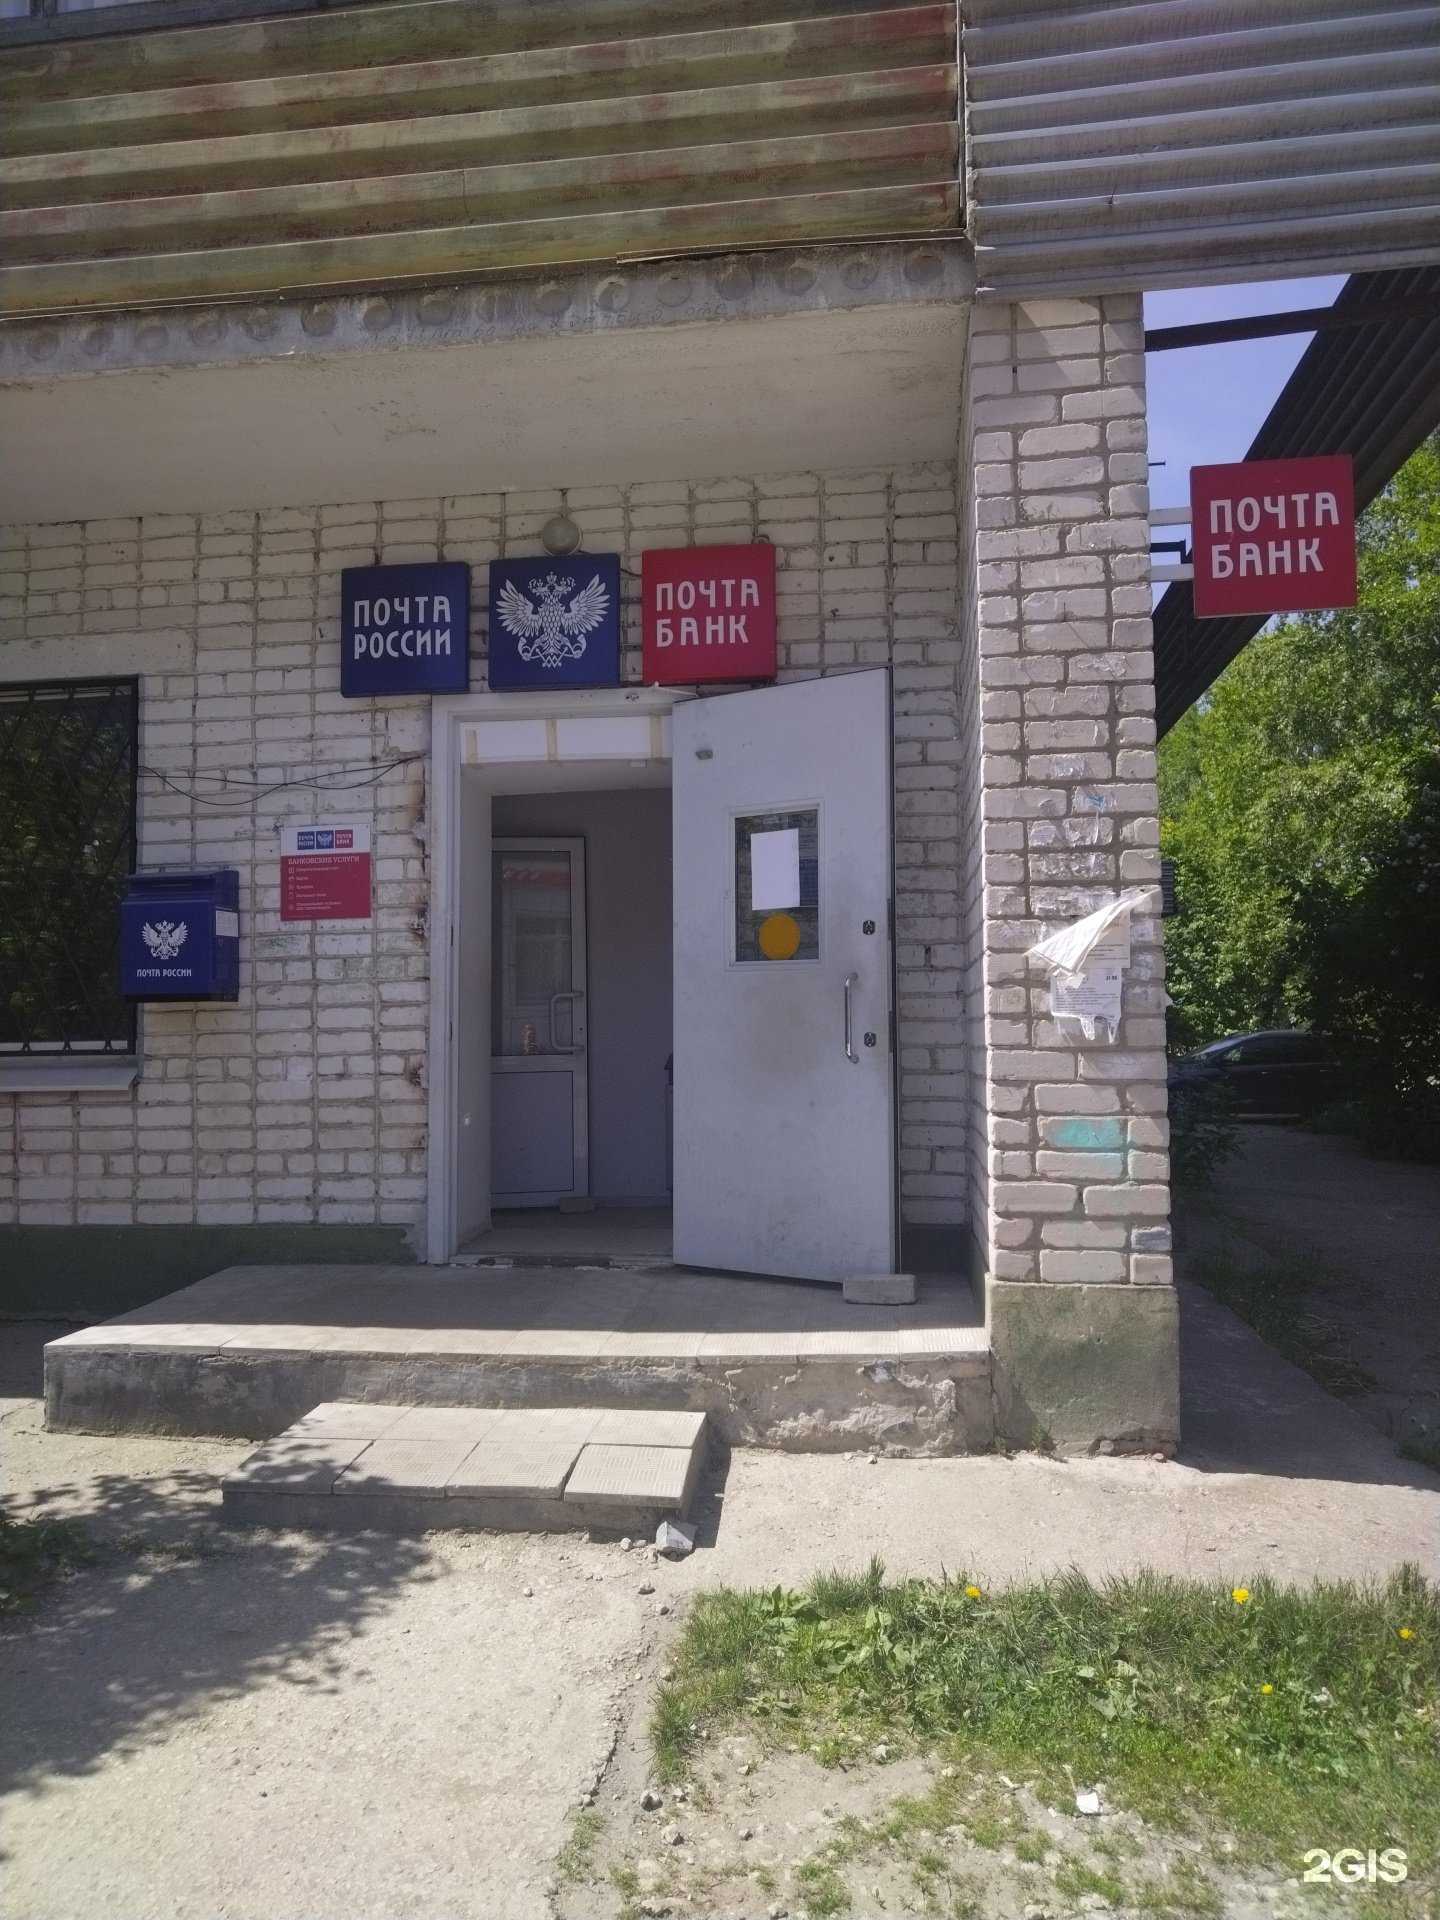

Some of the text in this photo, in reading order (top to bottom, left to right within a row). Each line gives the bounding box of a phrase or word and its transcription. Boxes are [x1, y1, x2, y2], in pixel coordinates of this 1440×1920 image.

[1210, 492, 1340, 534] ПОЧТА
[1211, 538, 1324, 579] БАНК
[354, 596, 451, 628] ПОЧТА
[656, 579, 760, 612] ПОЧТА
[354, 628, 451, 660] РОССИИ
[656, 615, 749, 648] БАНК
[137, 968, 192, 977] ПОЧТА РОССИИ
